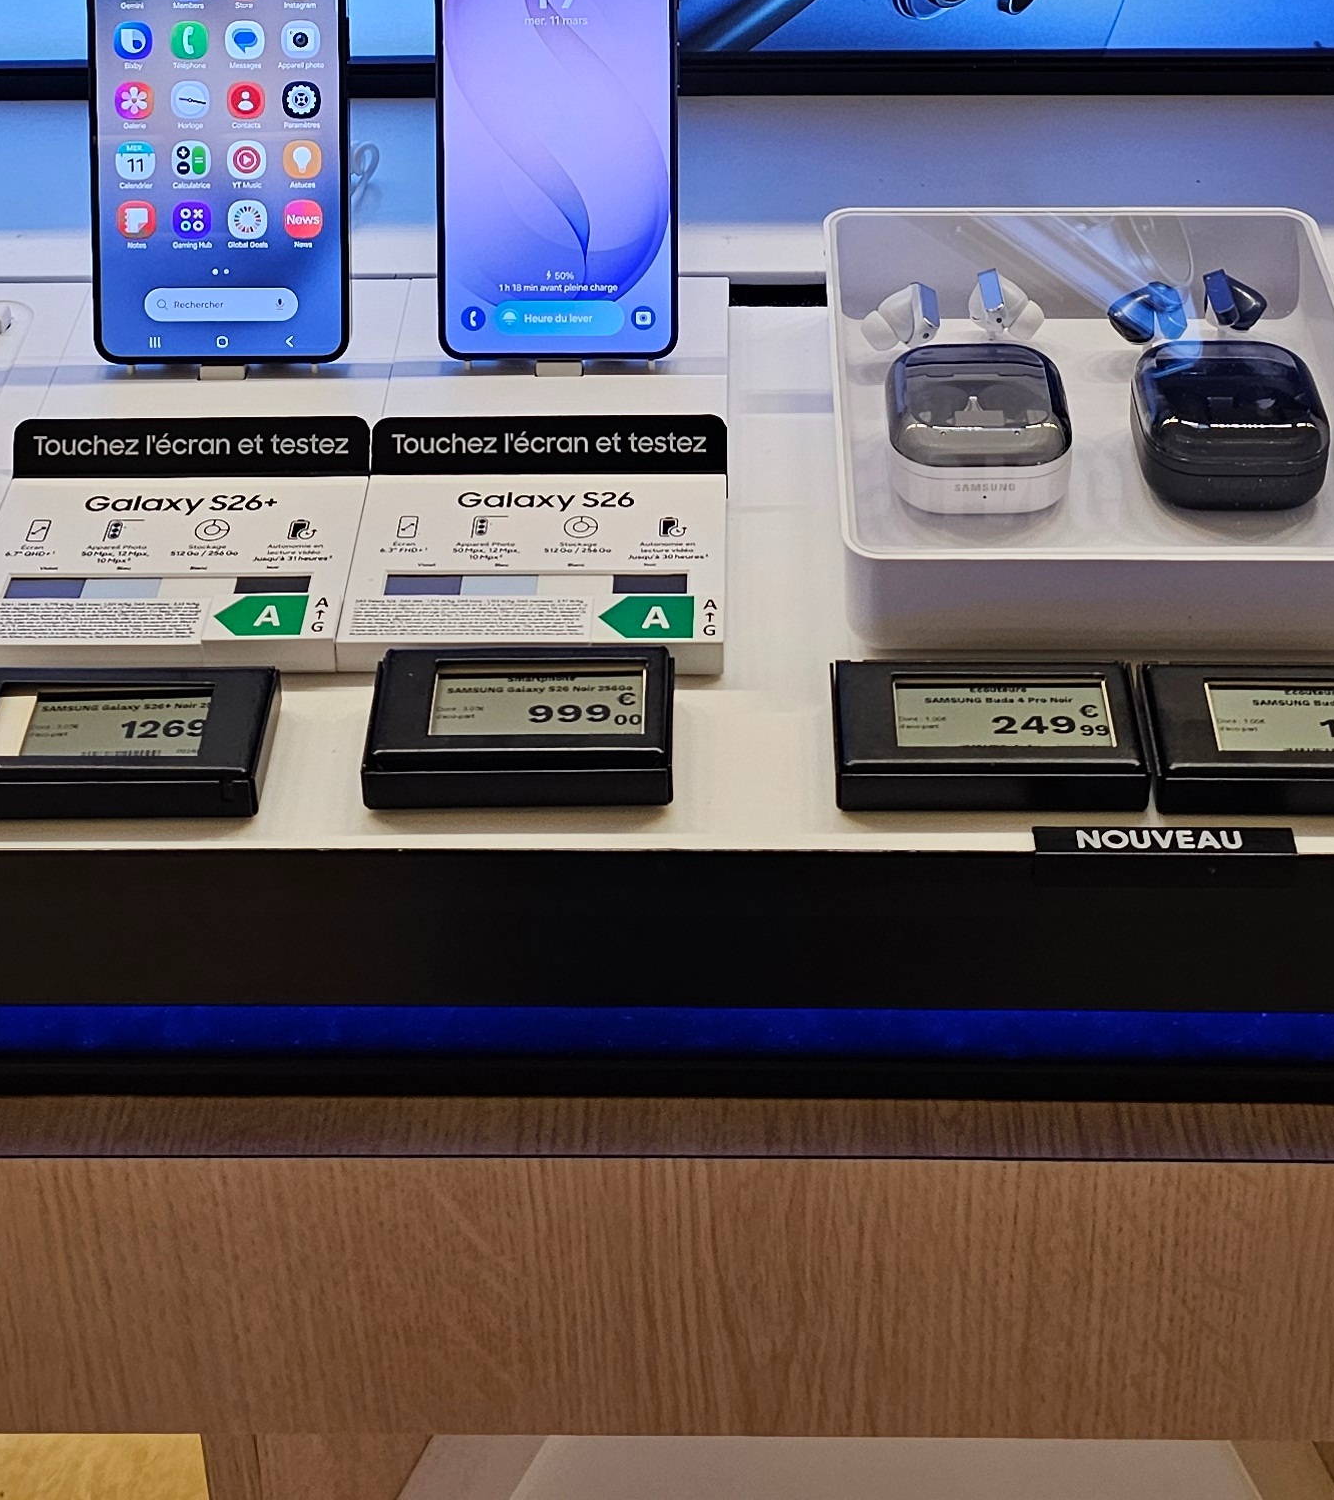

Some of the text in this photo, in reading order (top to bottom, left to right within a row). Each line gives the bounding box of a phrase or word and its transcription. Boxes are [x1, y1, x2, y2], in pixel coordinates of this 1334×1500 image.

[283, 2, 317, 10] Instagram
[173, 62, 206, 70] Téléphone
[278, 62, 324, 70] Appareil photo
[283, 121, 320, 129] Paramètres
[127, 158, 143, 172] 11
[287, 214, 320, 224] News
[555, 272, 574, 280] 50%
[174, 300, 223, 308] Rechercher
[524, 313, 593, 324] Heure du lever
[34, 434, 348, 455] Touchez l'écran et testez
[391, 433, 707, 454] Touchez l'écran et testez
[954, 482, 1015, 491] SAMSUNG
[85, 495, 277, 515] Galaxy S26+
[458, 492, 636, 511] Galaxy S26
[253, 606, 280, 627] A
[641, 606, 670, 629] A
[447, 686, 504, 694] SAMSUNG
[506, 686, 544, 695] Galaxy
[548, 685, 570, 693] S26
[527, 692, 642, 725] 999 € 00
[992, 704, 1109, 736] 249 € 99
[121, 720, 205, 738] 1269
[1077, 830, 1243, 850] NOUVEAU
